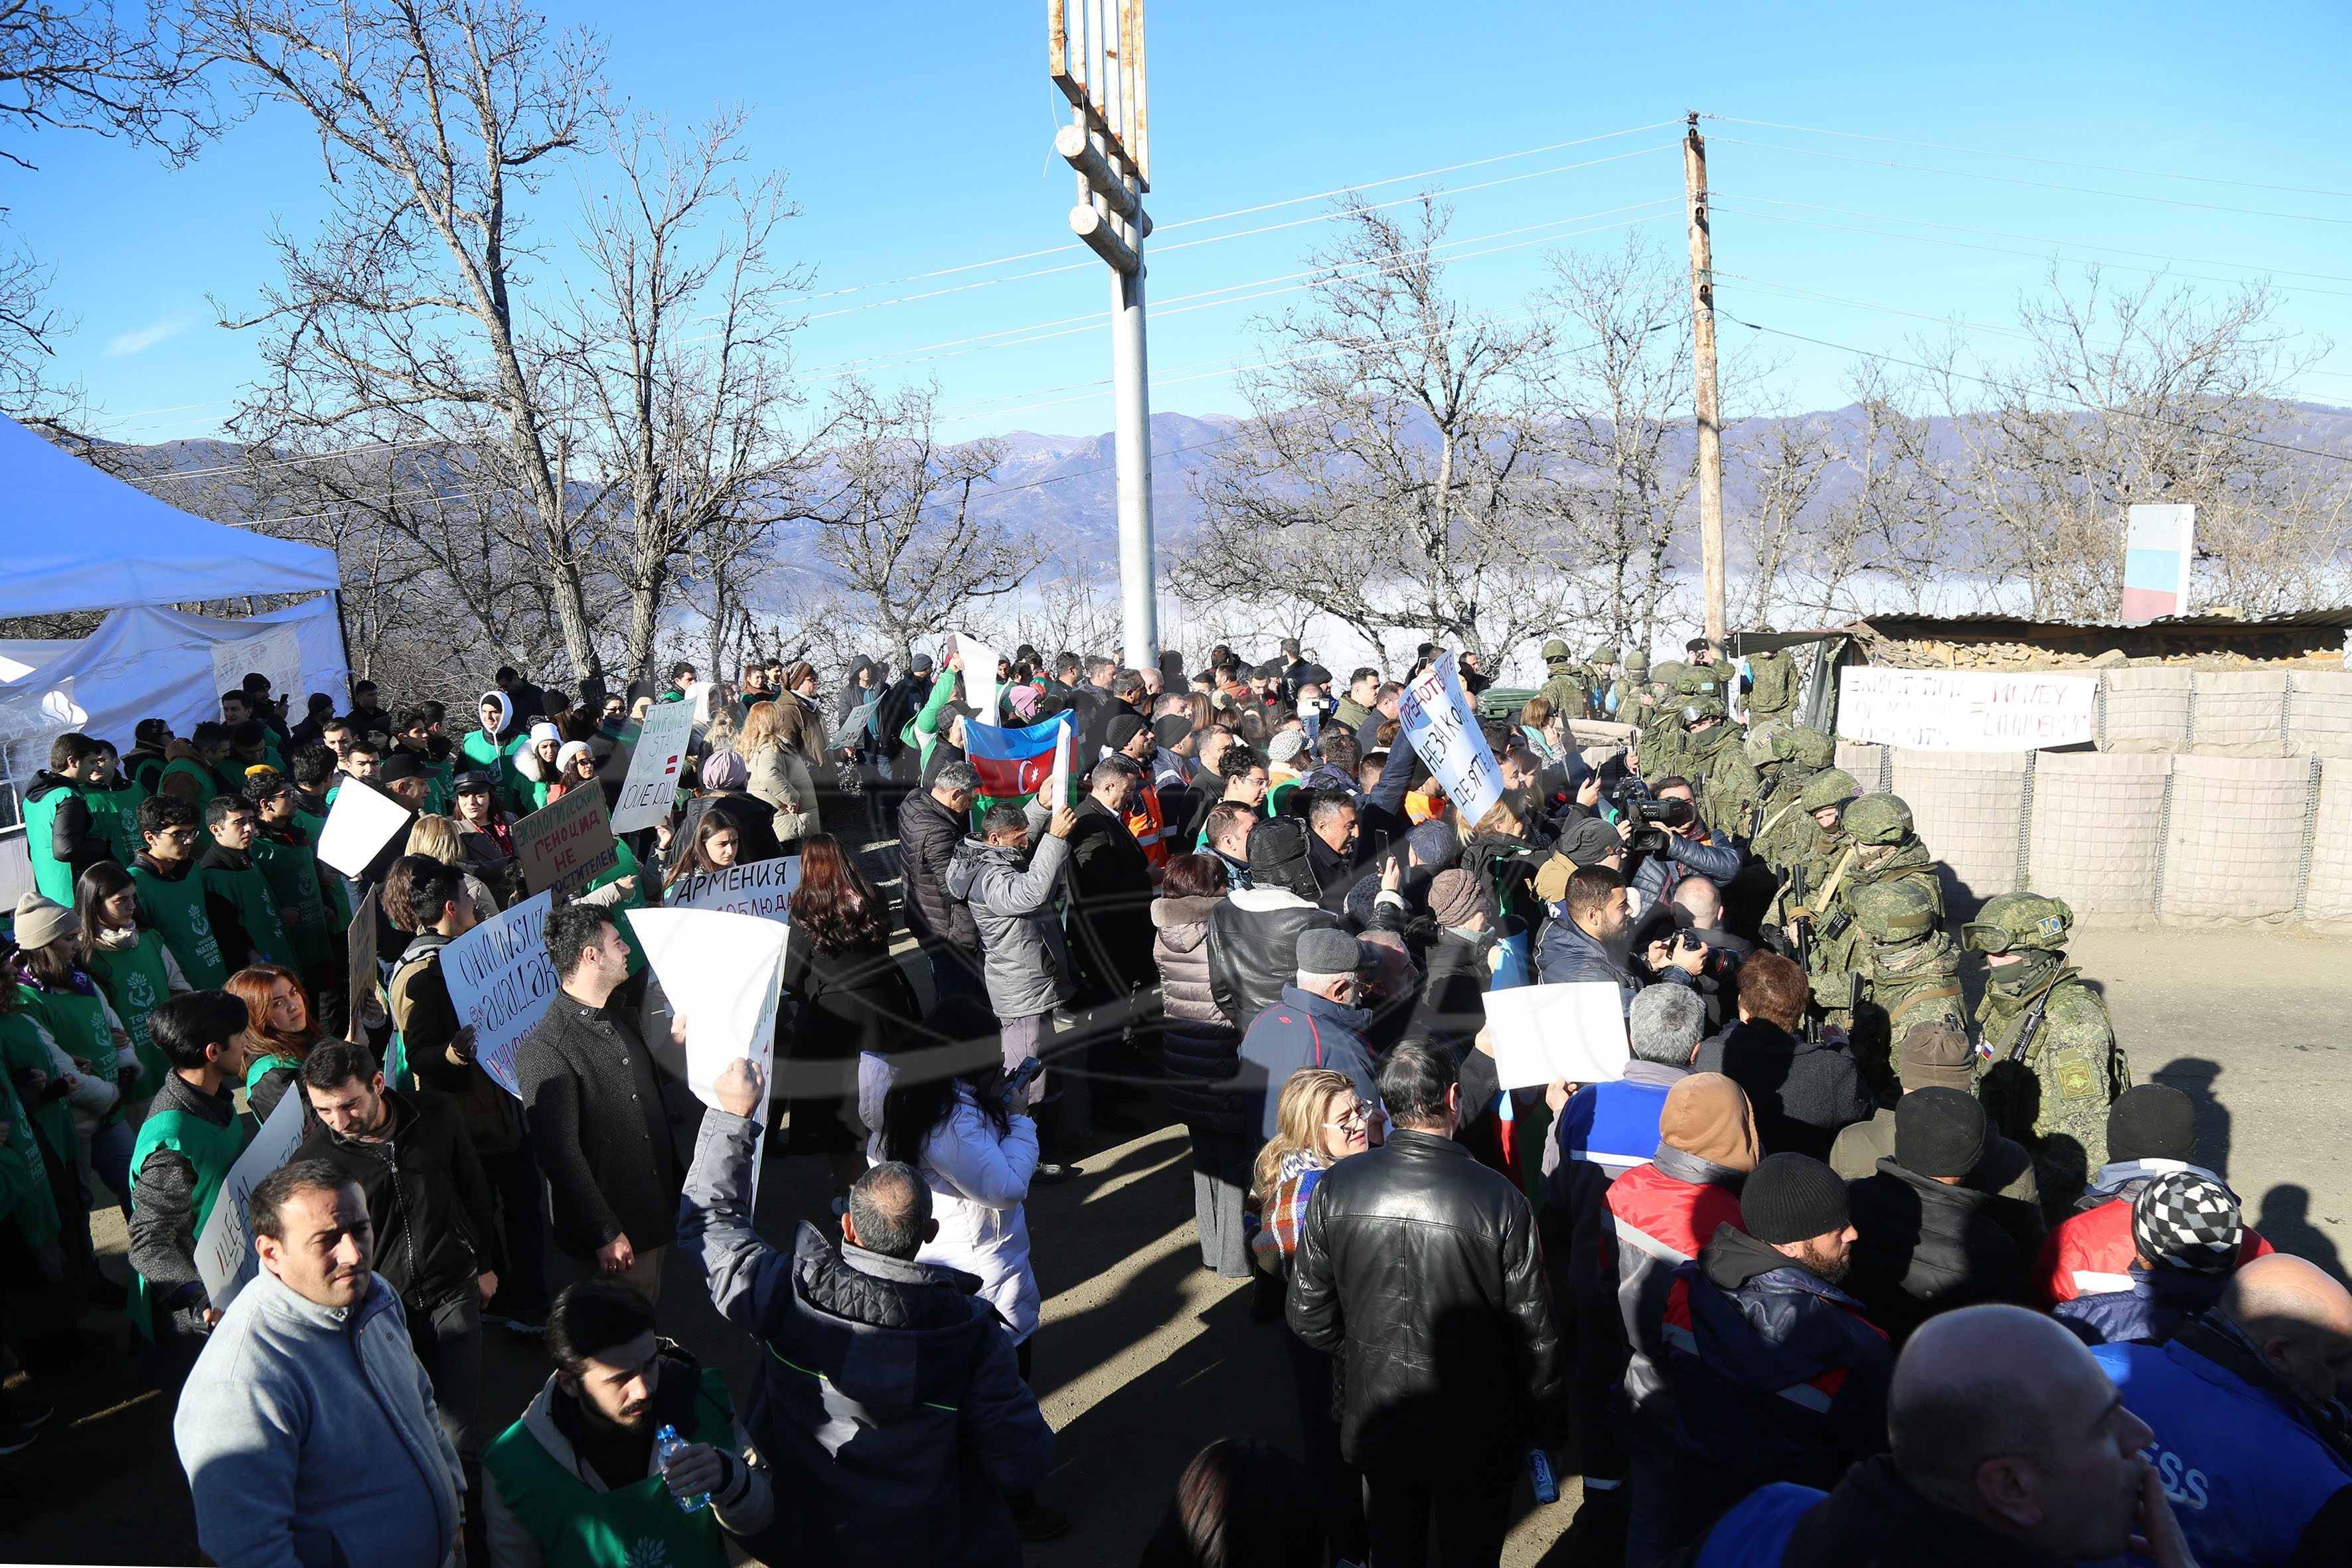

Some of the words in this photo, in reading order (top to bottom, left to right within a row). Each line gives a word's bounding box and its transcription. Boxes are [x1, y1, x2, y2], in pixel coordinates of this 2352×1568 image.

[1992, 681, 2069, 706] MONEY
[534, 809, 601, 862] ГЕНОЦИД
[554, 847, 577, 874] НЕ
[674, 861, 787, 906] АРМЕНИЯ
